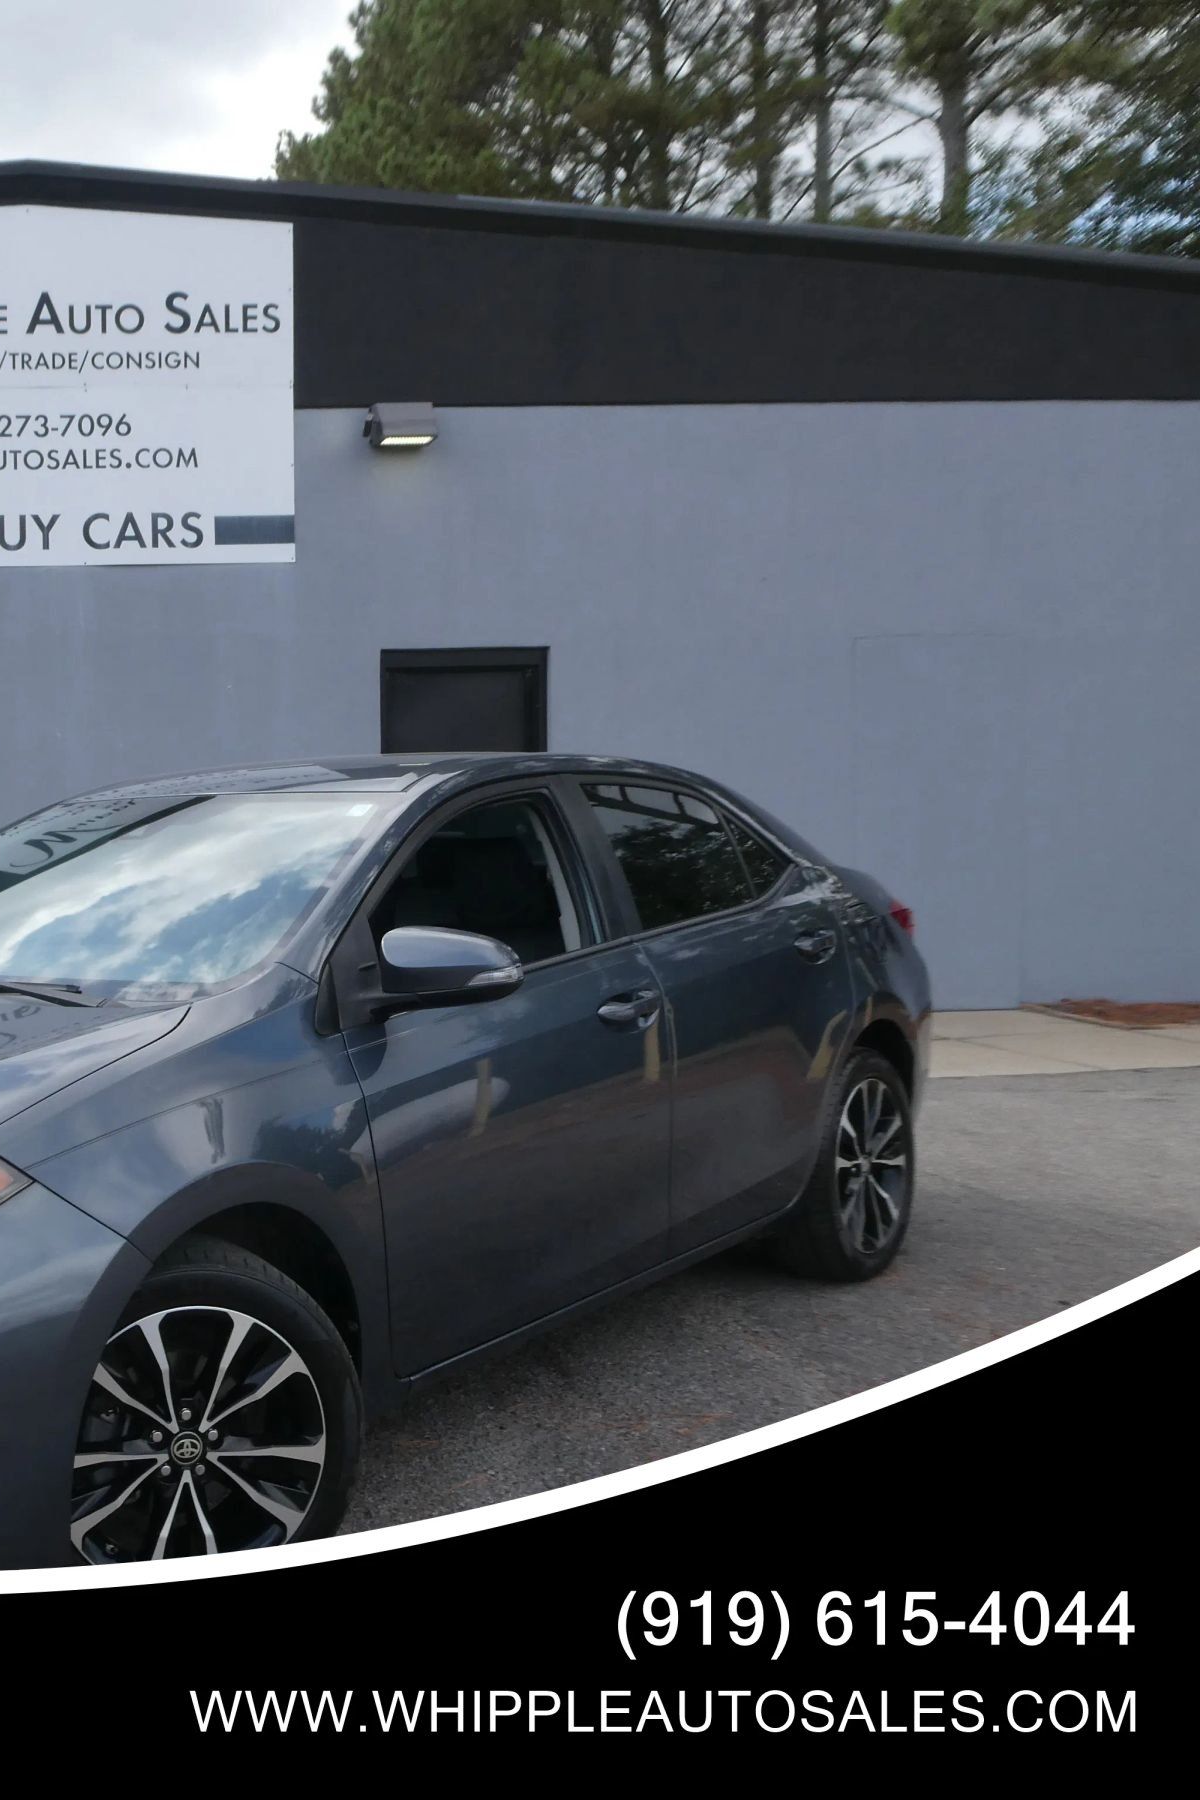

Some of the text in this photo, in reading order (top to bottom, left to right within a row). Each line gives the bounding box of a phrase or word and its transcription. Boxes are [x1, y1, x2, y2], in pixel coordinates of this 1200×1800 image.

[26, 292, 144, 335] AUTO
[164, 291, 281, 335] SALES
[82, 511, 204, 550] CARS
